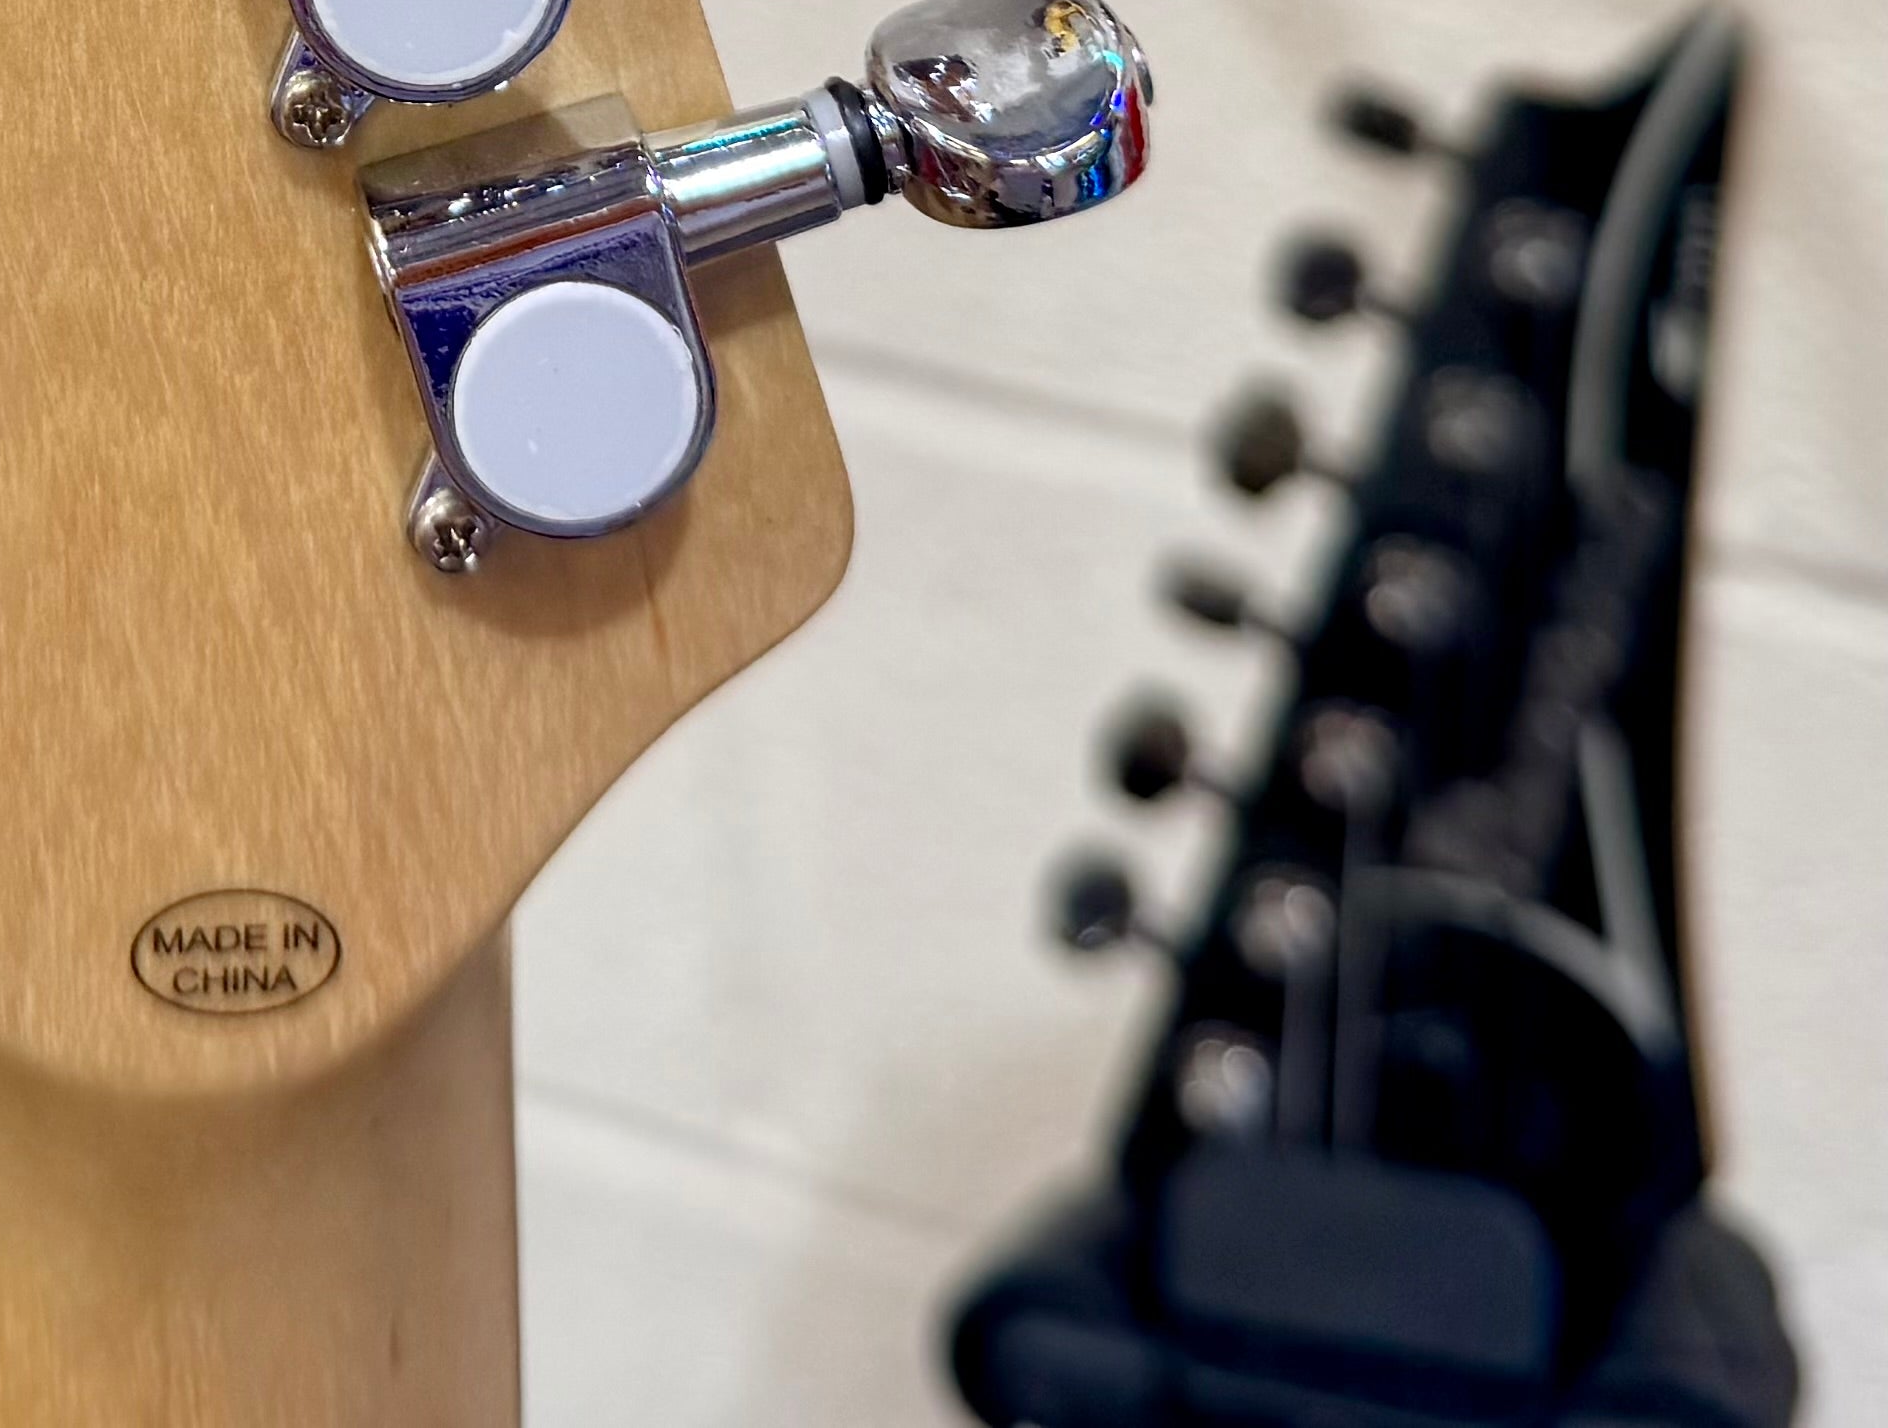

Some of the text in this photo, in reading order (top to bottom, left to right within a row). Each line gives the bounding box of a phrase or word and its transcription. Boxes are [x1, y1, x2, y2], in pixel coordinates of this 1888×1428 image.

[152, 921, 320, 954] MADE IN
[172, 964, 298, 994] CHINA
